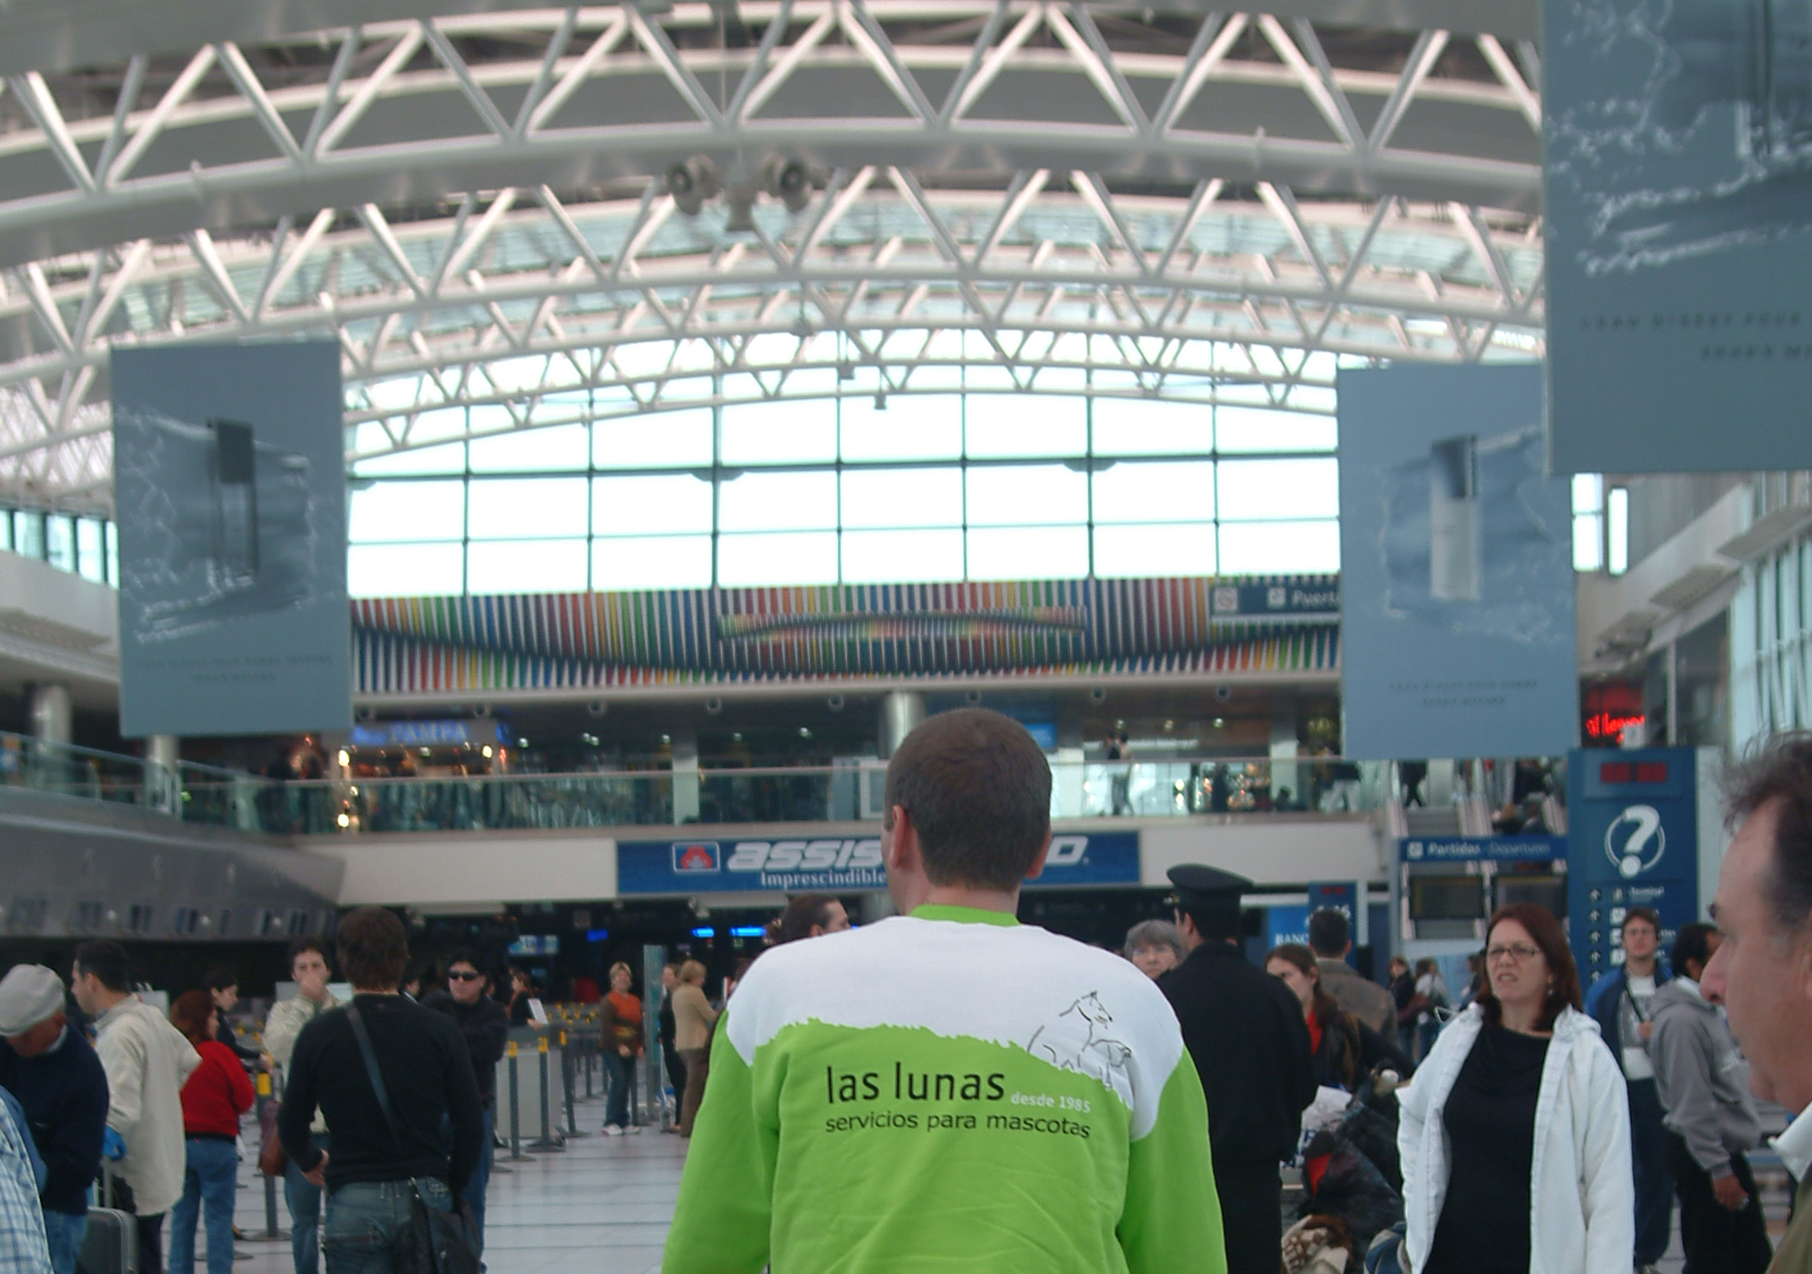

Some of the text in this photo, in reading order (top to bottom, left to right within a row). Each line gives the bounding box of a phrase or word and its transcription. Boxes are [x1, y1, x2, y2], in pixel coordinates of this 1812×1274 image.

[1427, 841, 1481, 855] Partidas
[827, 1061, 1091, 1114] las lunas desde 1985
[825, 1110, 1091, 1139] servicios para mascotas
